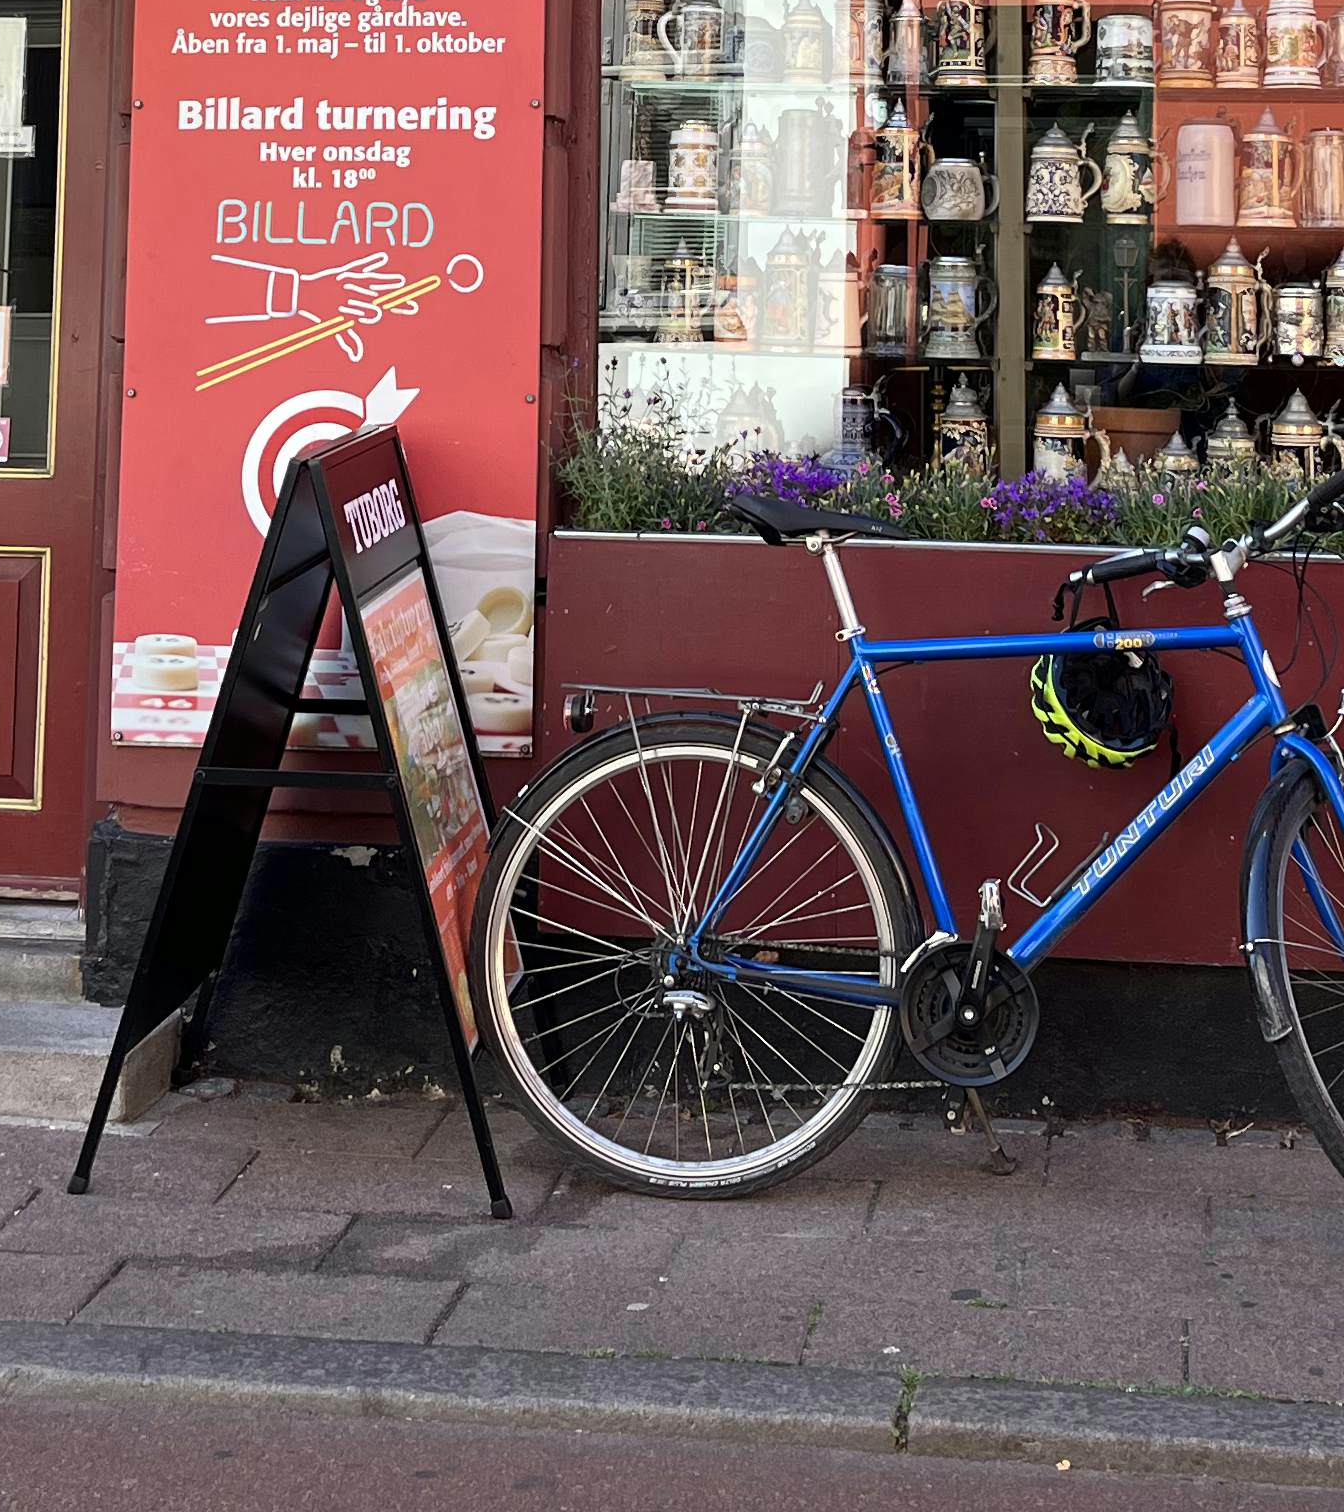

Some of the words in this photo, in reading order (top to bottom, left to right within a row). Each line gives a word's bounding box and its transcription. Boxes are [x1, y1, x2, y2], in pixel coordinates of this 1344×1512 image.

[209, 10, 270, 28] vores
[276, 6, 351, 33] dejlige
[357, 4, 467, 33] gårdhave.
[171, 29, 229, 54] Åben
[235, 33, 267, 54] fra
[276, 35, 292, 54] 1.
[297, 34, 339, 59] maj
[364, 33, 386, 54] til
[395, 34, 412, 54] 1.
[417, 33, 506, 54] oktober
[178, 97, 304, 131] Billard
[316, 97, 497, 139] turnering
[259, 142, 316, 162] Hver
[322, 141, 411, 167] onsdag
[292, 167, 322, 188] kl.
[216, 198, 435, 248] BILLARD
[343, 478, 406, 554] TUBORG
[1115, 638, 1143, 650] 200
[1071, 744, 1216, 896] TUNTURI
